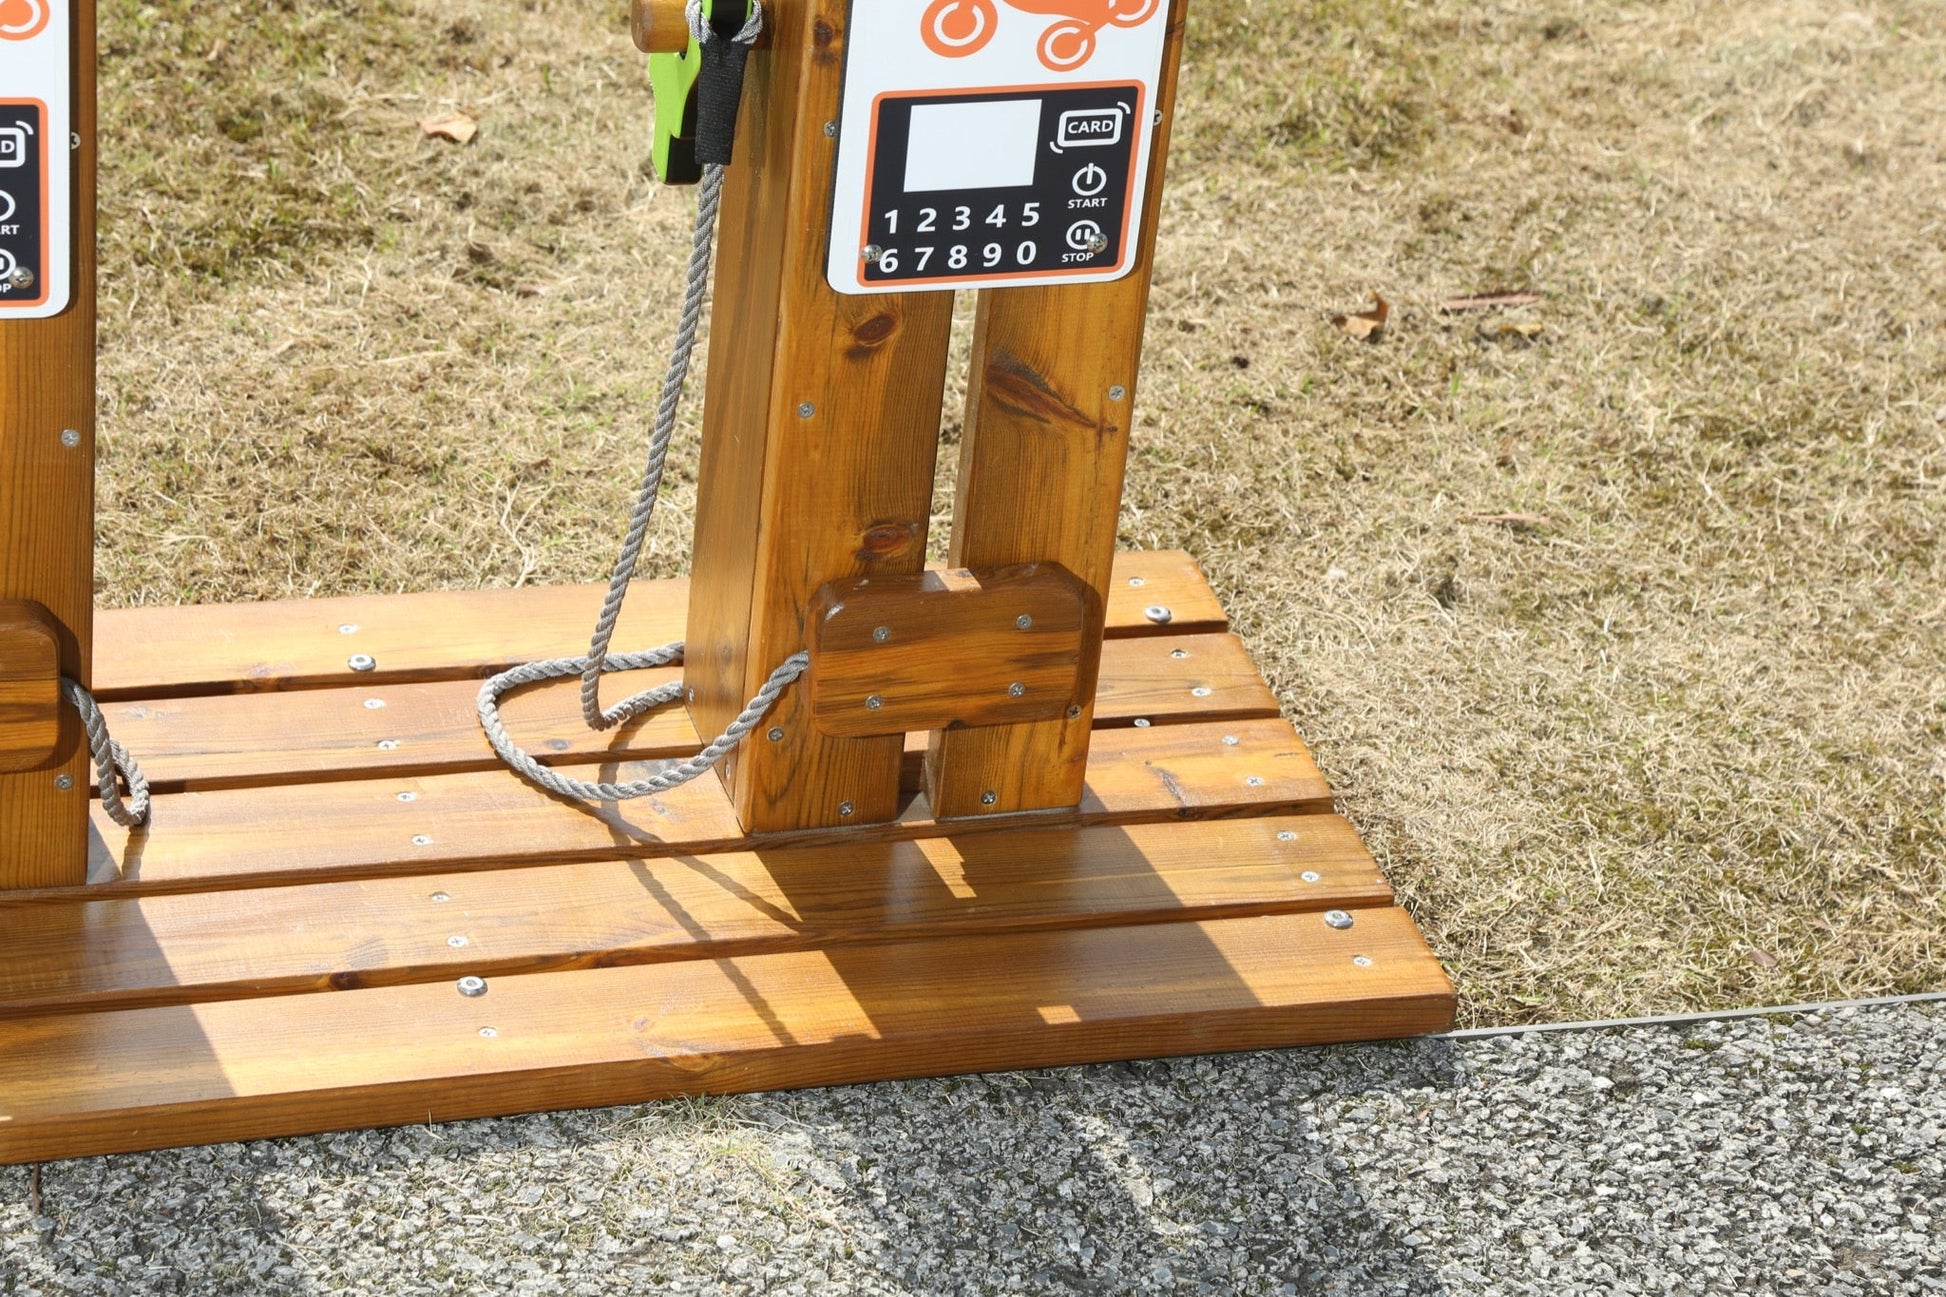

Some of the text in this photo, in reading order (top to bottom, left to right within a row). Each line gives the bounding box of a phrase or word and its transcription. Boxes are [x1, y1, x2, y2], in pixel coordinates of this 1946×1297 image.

[1067, 120, 1114, 134] CARD
[1067, 197, 1108, 209] START
[884, 202, 1040, 234] 1 2 3 4 5
[0, 224, 20, 235] RT
[878, 240, 1037, 273] 6 7 8 9 0
[1061, 251, 1095, 263] STOP
